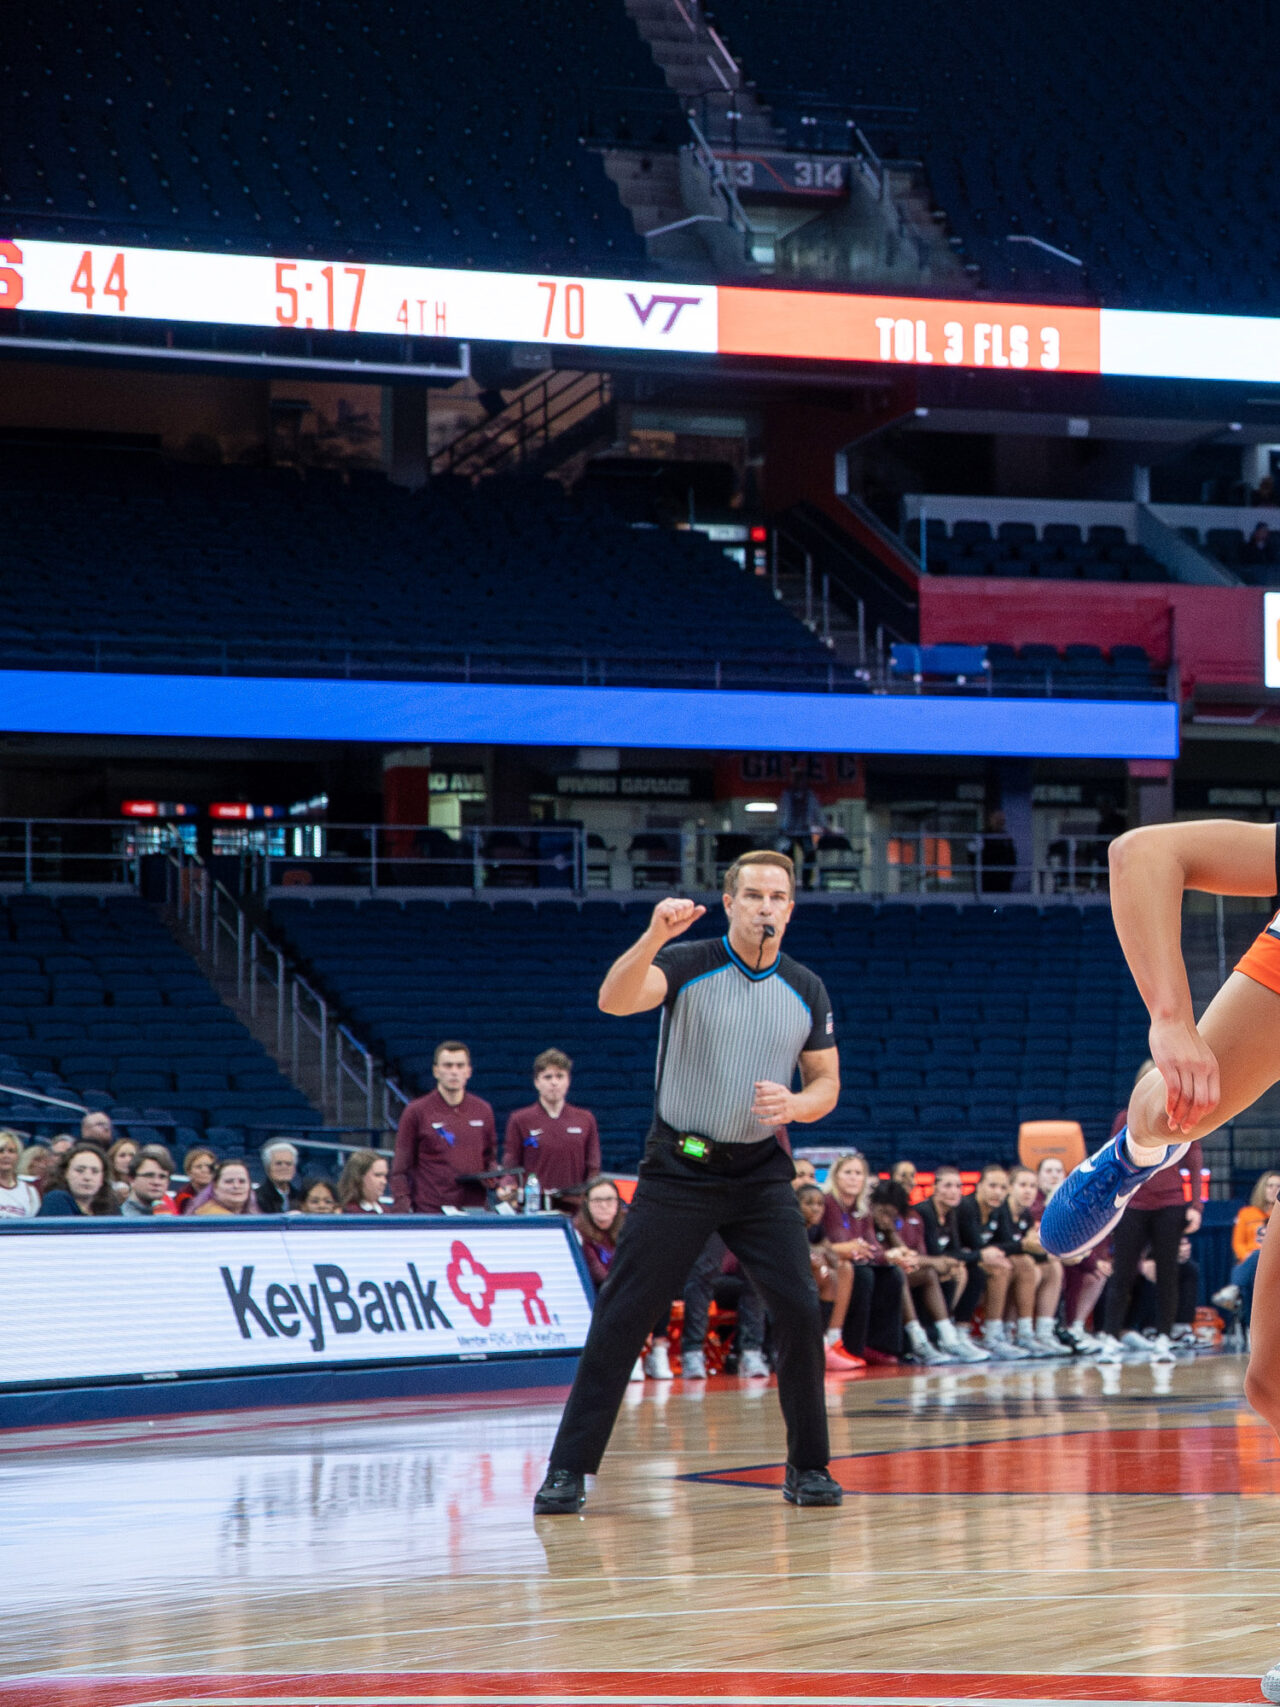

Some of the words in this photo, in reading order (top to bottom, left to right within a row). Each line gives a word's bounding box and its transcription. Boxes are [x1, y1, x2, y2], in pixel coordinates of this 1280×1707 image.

[795, 161, 843, 188] 314
[70, 250, 128, 311] 44
[275, 262, 366, 332] 5:17
[396, 299, 447, 337] 4TH
[537, 282, 585, 339] 70
[625, 293, 702, 334] VT
[875, 316, 934, 363] TOL
[943, 321, 964, 365] 3
[973, 322, 1029, 368] FLS
[1039, 326, 1061, 370] 3
[220, 1262, 454, 1352] KeyBank
